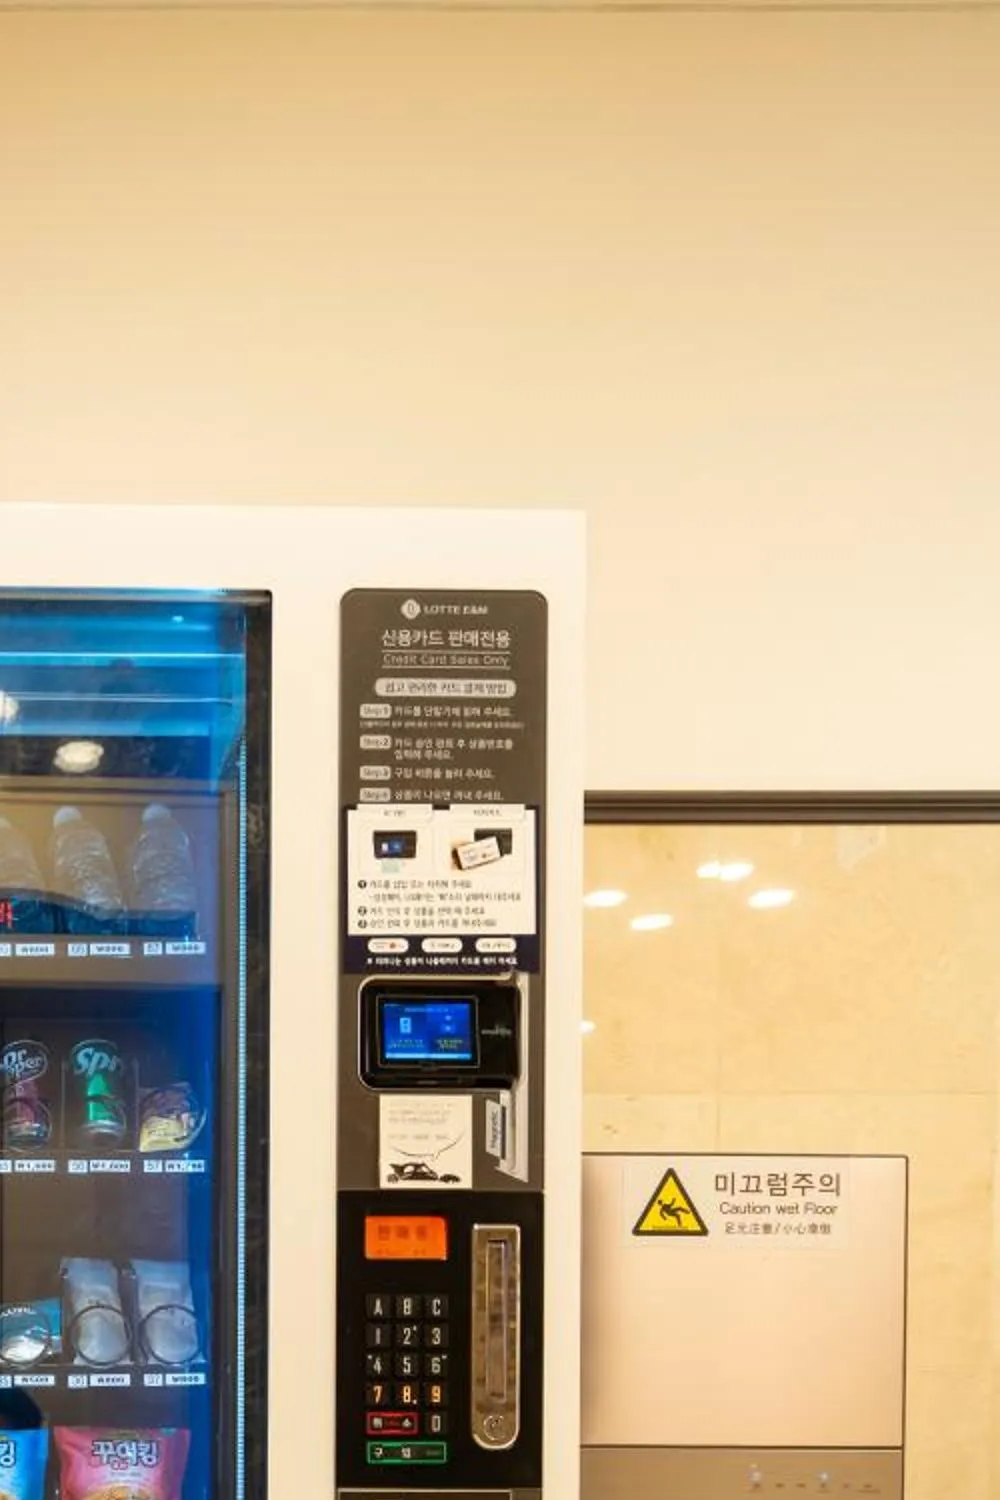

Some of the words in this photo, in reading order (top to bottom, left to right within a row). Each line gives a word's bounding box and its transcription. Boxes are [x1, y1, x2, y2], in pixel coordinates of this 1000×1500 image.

[423, 605, 460, 615] LOTTE
[383, 654, 417, 665] Credit
[714, 1171, 842, 1197] 미끄럼주의
[719, 1201, 771, 1215] Caution
[775, 1202, 800, 1215] wet
[803, 1202, 838, 1215] Floor
[373, 1298, 383, 1316] A
[403, 1298, 412, 1316] B
[432, 1298, 441, 1316] C
[375, 1328, 381, 1345] 1
[403, 1328, 412, 1345] 2
[431, 1328, 441, 1345] 3
[373, 1356, 382, 1374] 4
[403, 1356, 412, 1374] 5
[431, 1356, 441, 1374] 6
[373, 1385, 383, 1404] 7
[403, 1385, 412, 1403] 8
[431, 1385, 441, 1403] 9
[431, 1415, 441, 1433] 0
